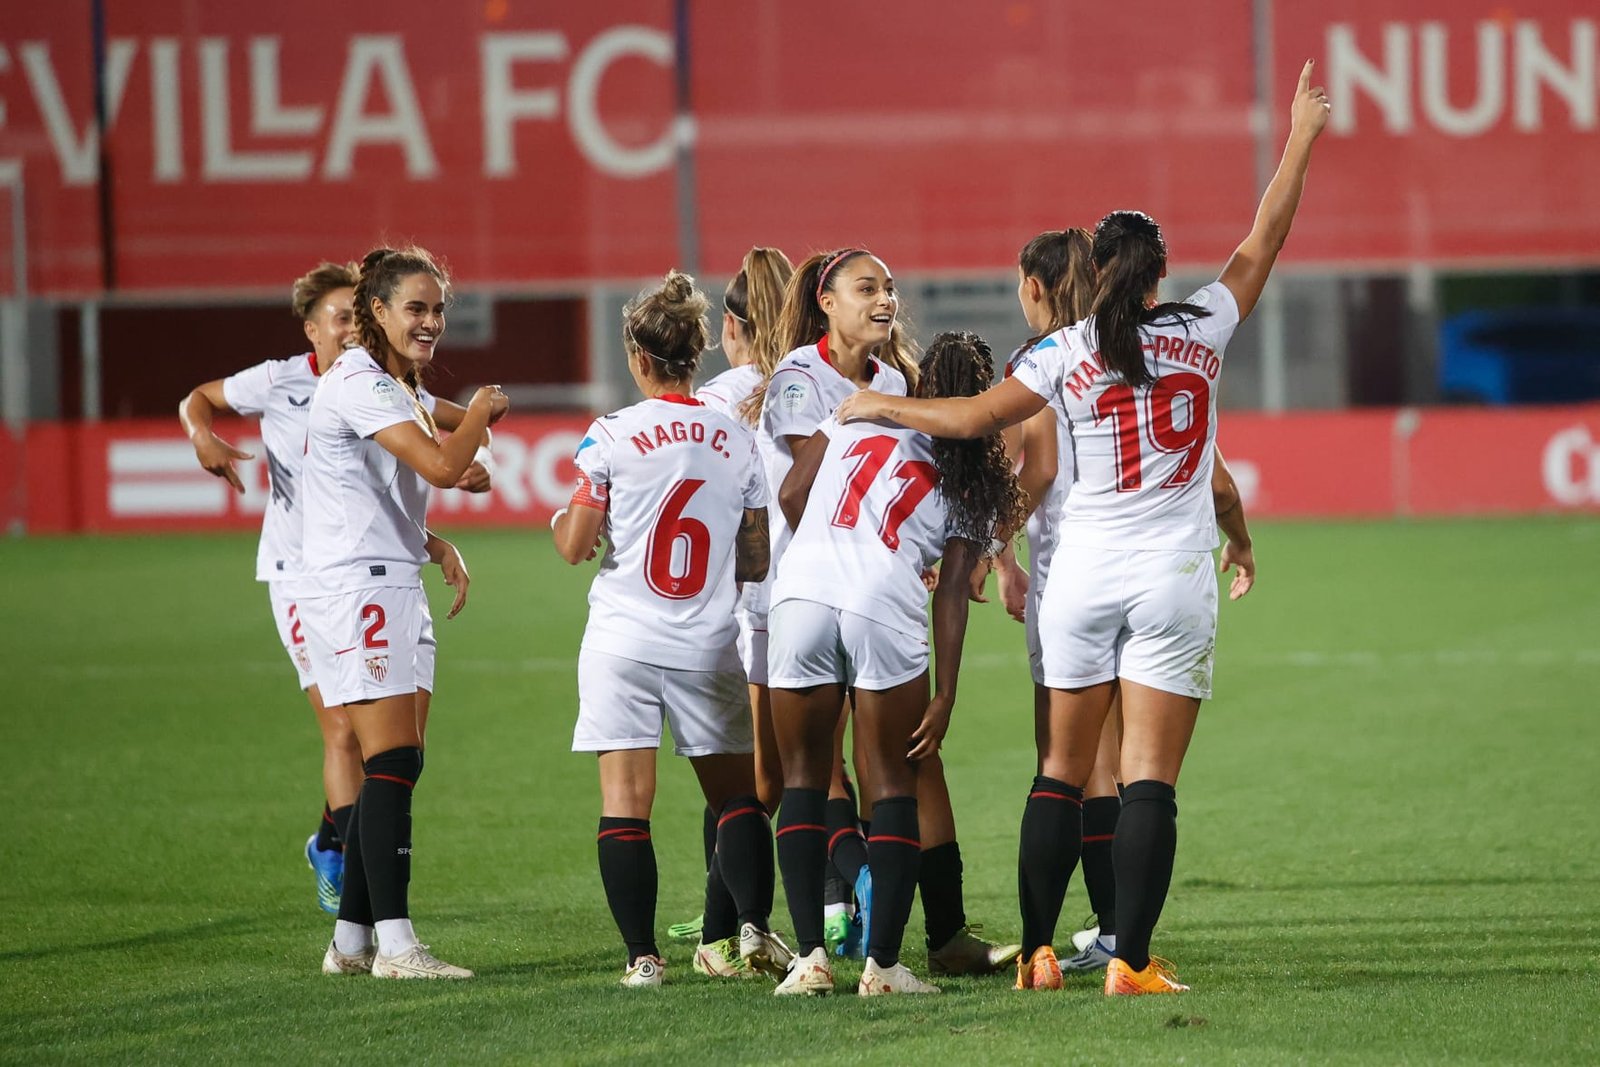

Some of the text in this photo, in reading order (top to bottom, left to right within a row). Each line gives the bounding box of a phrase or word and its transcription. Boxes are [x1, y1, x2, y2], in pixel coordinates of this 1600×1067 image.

[0, 26, 678, 184] VILLA FC
[1327, 20, 1600, 136] NUN
[1065, 335, 1220, 401] MA-PRIETO
[630, 421, 731, 459] NAGO C.
[1091, 372, 1210, 493] 19
[643, 478, 711, 600] 6
[831, 434, 942, 553] 11
[361, 603, 389, 650] 2
